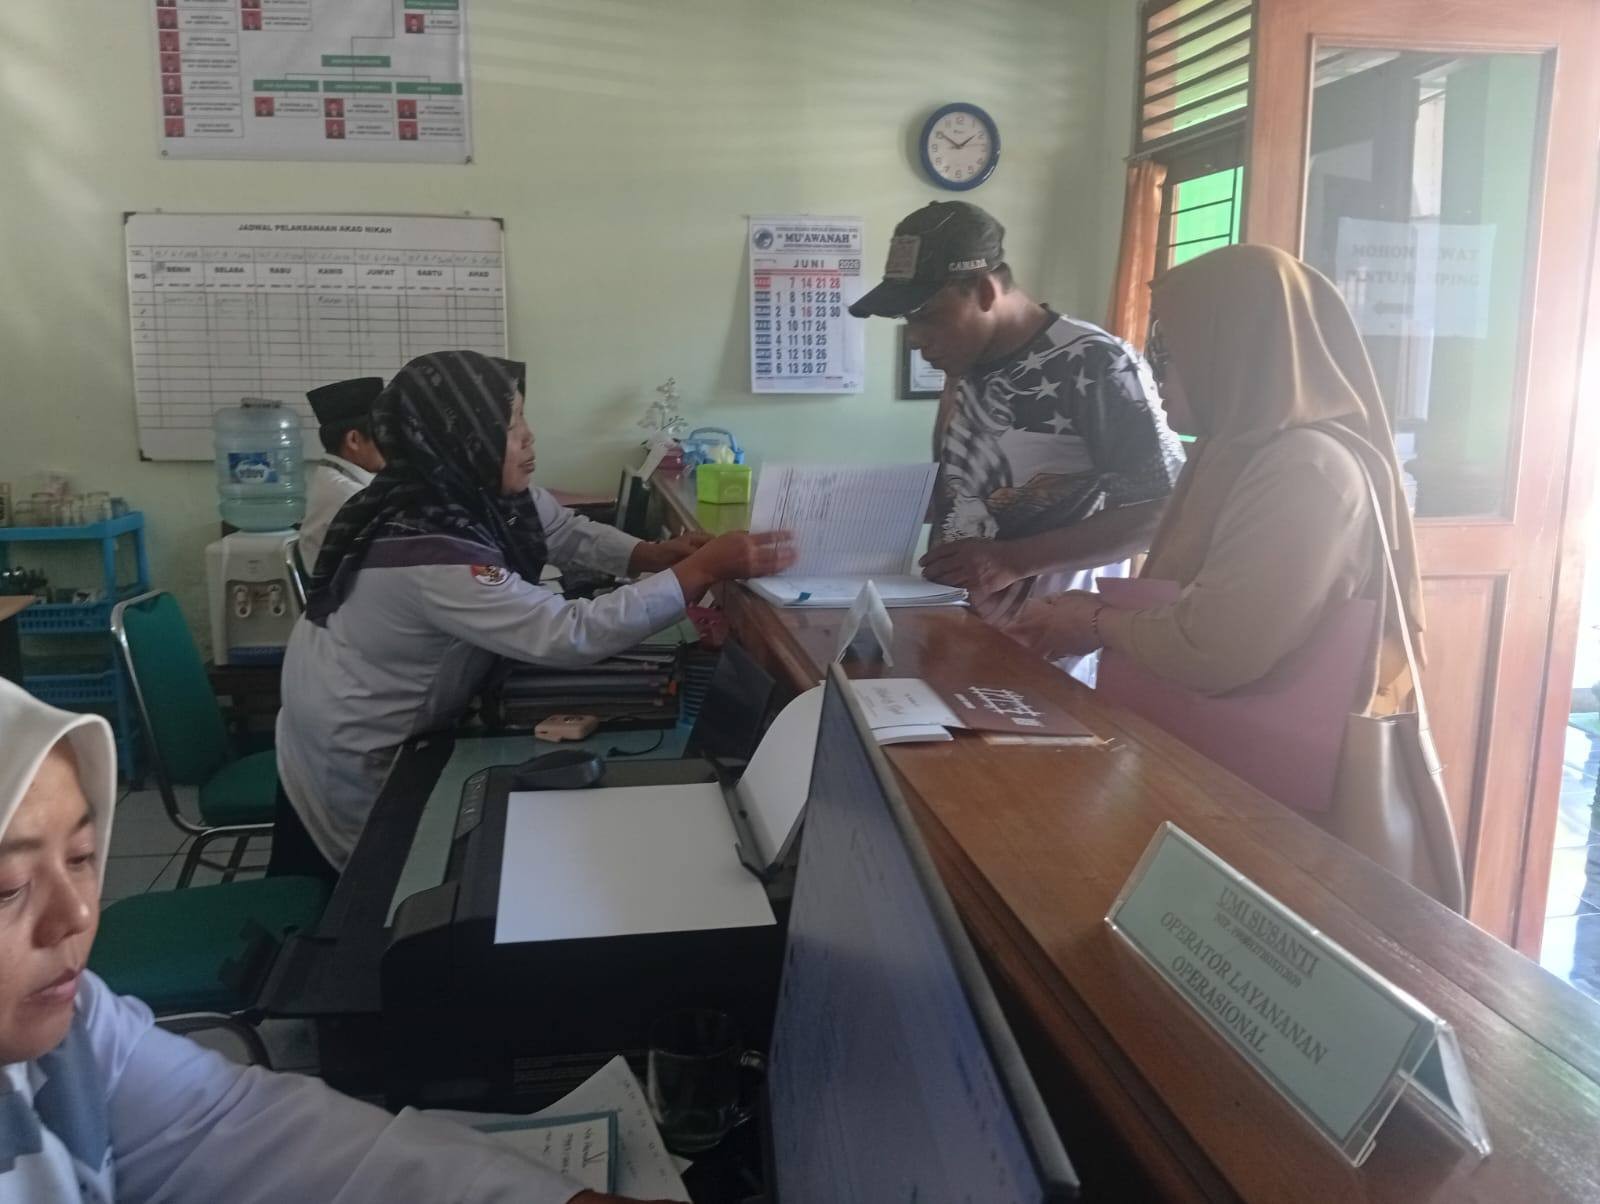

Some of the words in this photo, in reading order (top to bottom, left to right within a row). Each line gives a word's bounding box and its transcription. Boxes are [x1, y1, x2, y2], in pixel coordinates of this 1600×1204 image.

[793, 259, 825, 268] JUNI
[790, 277, 796, 289] 7
[801, 277, 813, 289] 14
[815, 277, 827, 289] 21
[776, 291, 781, 303] 1
[801, 291, 813, 303] 15
[815, 291, 827, 303] 22
[829, 291, 841, 303] 29
[776, 305, 782, 317] 2
[790, 305, 796, 317] 9
[815, 305, 827, 317] 23
[829, 305, 841, 317] 30
[776, 320, 782, 331] 3
[788, 320, 798, 331] 10
[801, 320, 813, 331] 17
[815, 320, 827, 331] 24
[776, 334, 782, 346] 4
[788, 334, 798, 346] 11
[815, 334, 827, 346] 25
[776, 348, 782, 360] 5
[788, 348, 798, 360] 12
[801, 348, 813, 360] 19
[815, 348, 827, 360] 26
[788, 362, 798, 374] 13
[801, 362, 813, 374] 20
[815, 362, 827, 374] 27
[1216, 886, 1250, 921] UMI
[1246, 908, 1320, 979] SUSANTI
[1160, 911, 1233, 980] OPERATOR
[1227, 970, 1329, 1066] LAYANANAN
[1171, 955, 1270, 1054] OPERASIONAL
